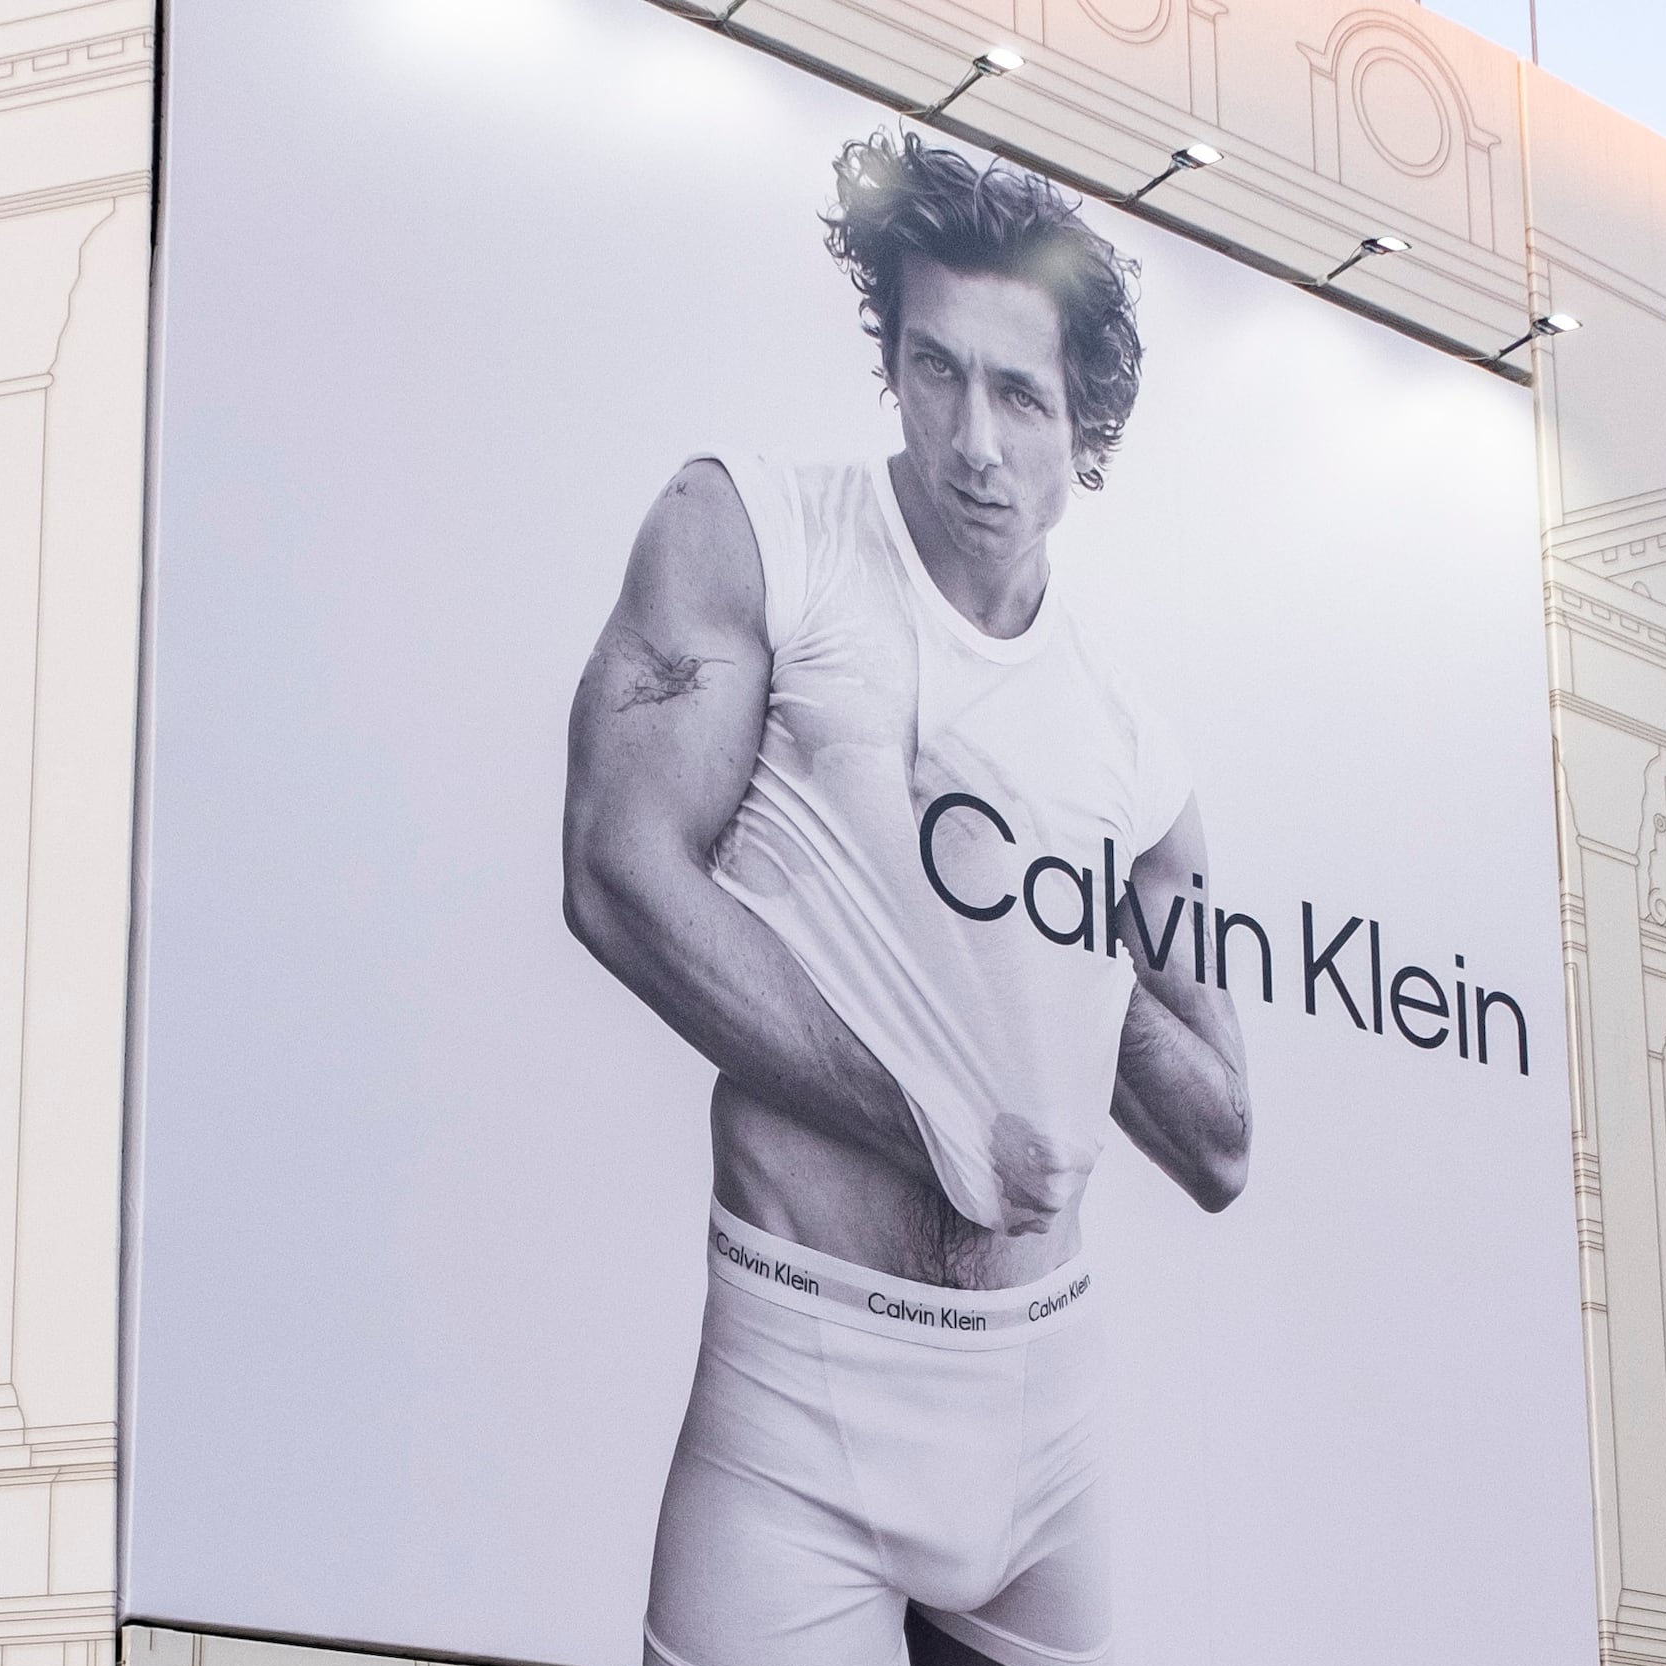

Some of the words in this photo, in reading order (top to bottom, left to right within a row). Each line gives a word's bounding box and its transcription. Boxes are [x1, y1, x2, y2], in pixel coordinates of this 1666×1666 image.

[919, 792, 1273, 1003] Calvin
[1301, 901, 1530, 1077] Klein
[716, 1232, 770, 1279] Calvin
[774, 1260, 819, 1296] Klein
[868, 1292, 935, 1327] Calvin
[940, 1308, 986, 1331] Klein
[1027, 1290, 1069, 1324] Calvin
[1069, 1272, 1092, 1304] Klein
